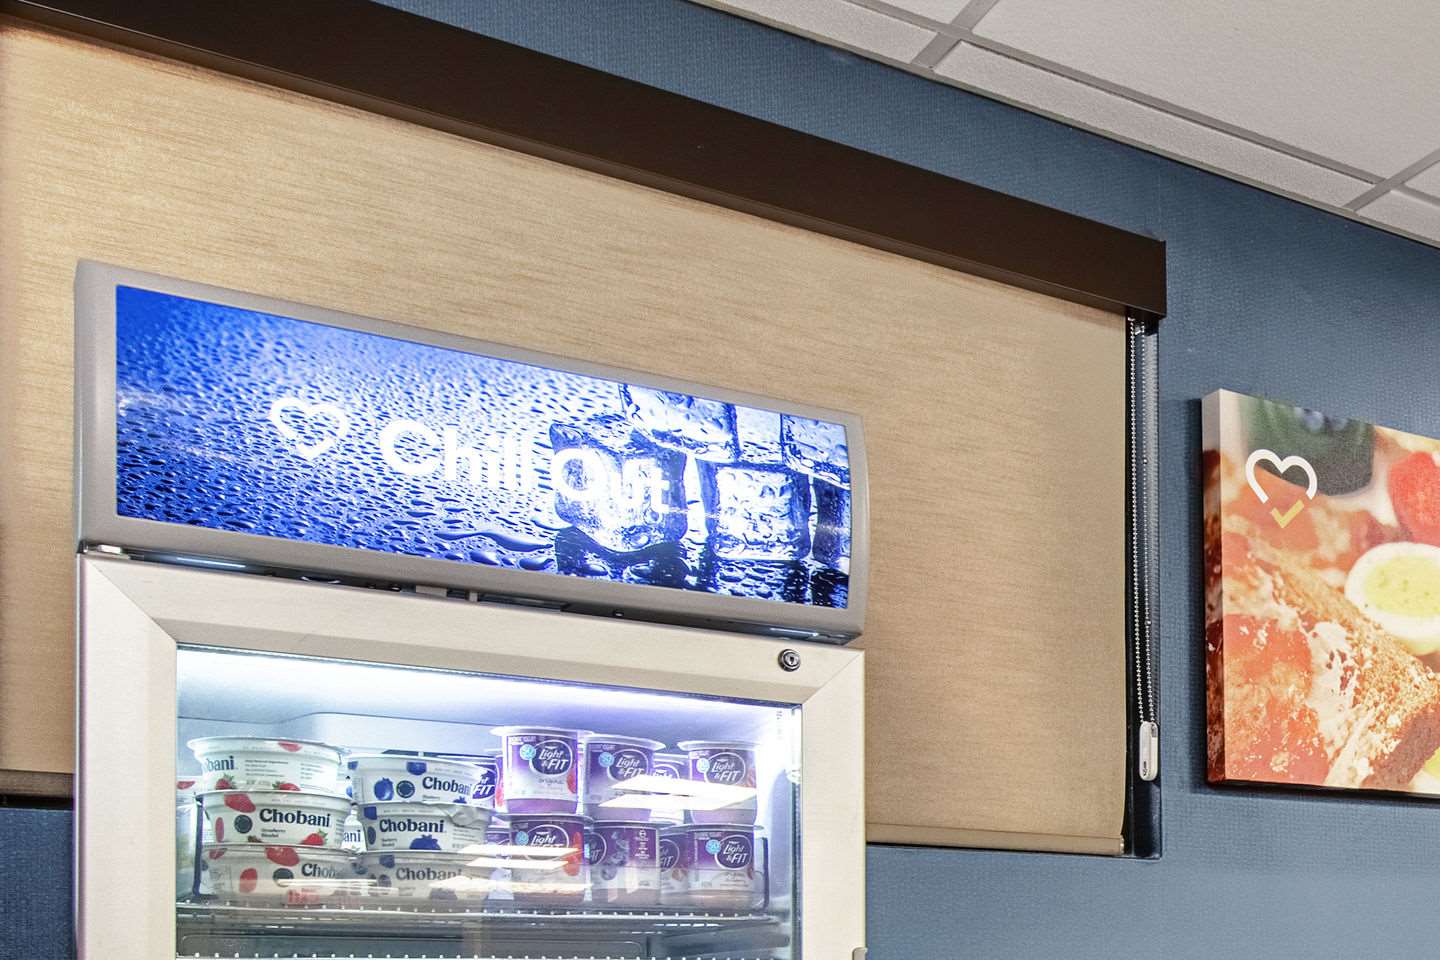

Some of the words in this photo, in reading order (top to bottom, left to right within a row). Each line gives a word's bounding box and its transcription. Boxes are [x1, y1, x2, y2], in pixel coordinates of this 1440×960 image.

[379, 418, 534, 491] Chill
[551, 447, 671, 514] Out
[538, 748, 565, 761] Light
[547, 759, 569, 770] FIT
[616, 757, 640, 768] Light
[720, 770, 741, 781] FIT
[260, 808, 331, 828] Chobani
[379, 818, 445, 833] Chobani
[731, 852, 749, 864] FIT
